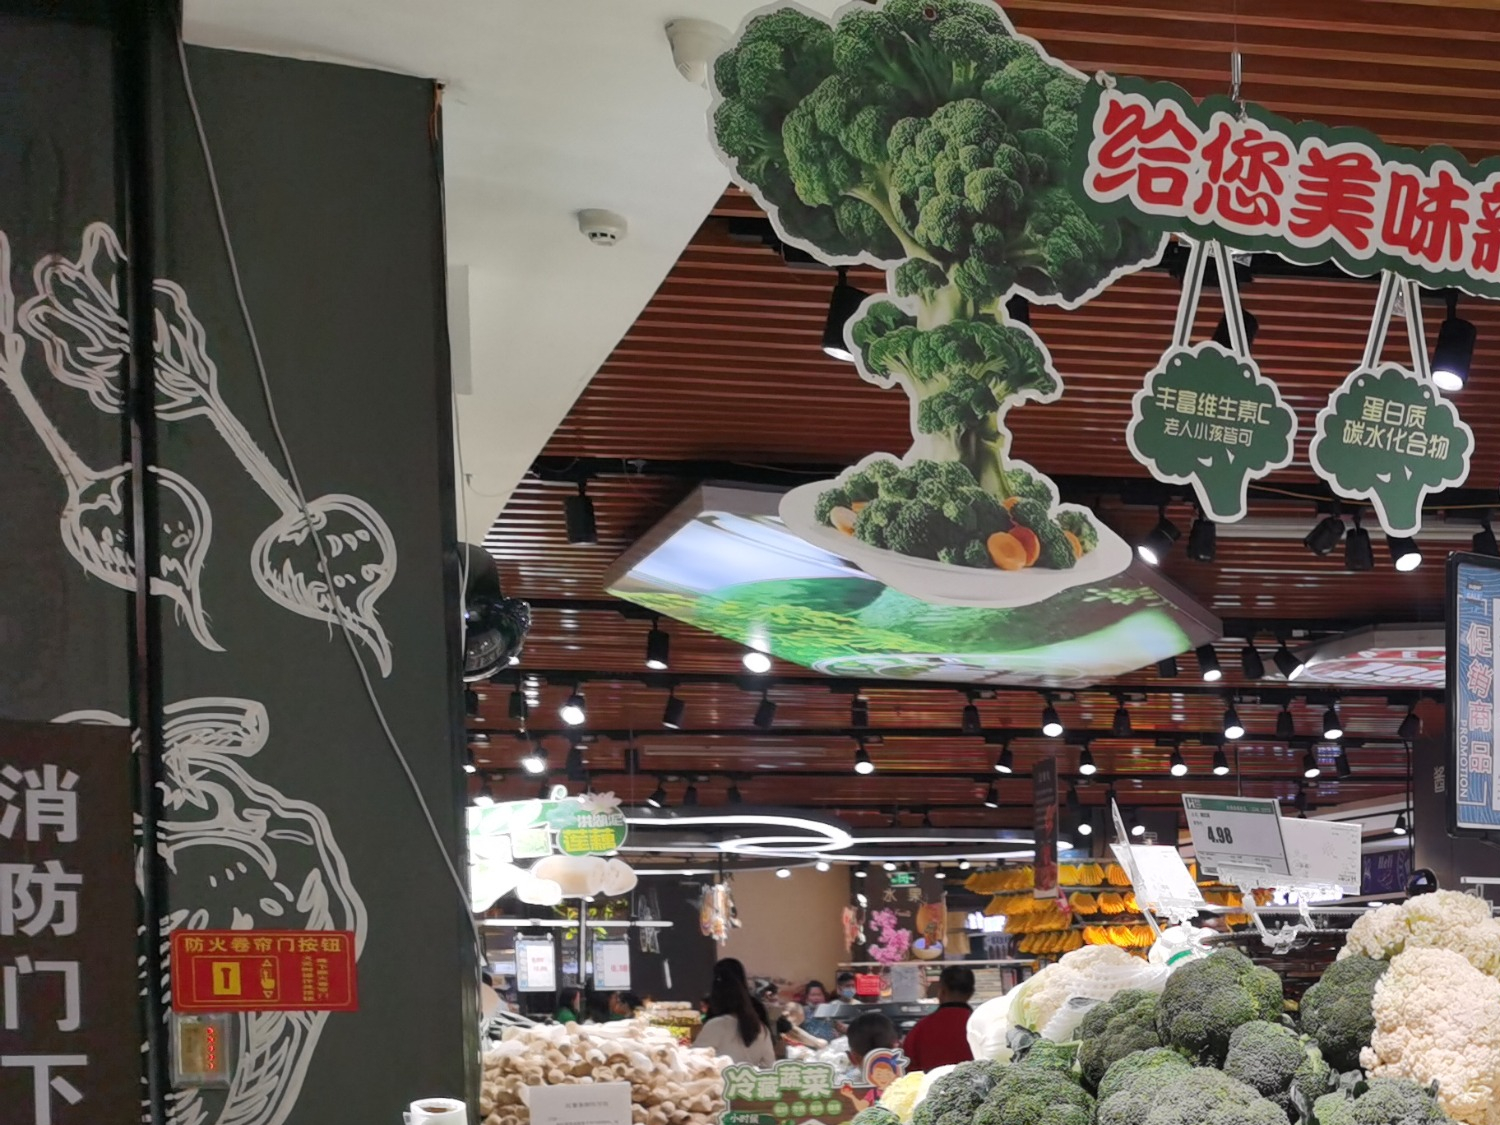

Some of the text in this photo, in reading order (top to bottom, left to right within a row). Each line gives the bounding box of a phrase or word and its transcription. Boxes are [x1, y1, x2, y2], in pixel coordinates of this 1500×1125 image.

[1361, 396, 1428, 430] 蛋白质
[1164, 417, 1254, 448] 老人小孩皆可
[1342, 419, 1450, 461] 碳水化合物
[1466, 622, 1493, 774] 促销商品
[1460, 719, 1469, 798] PROMOTION
[1207, 826, 1233, 844] 4.98
[185, 937, 341, 952] 防火卷帘门按钮
[727, 1066, 832, 1099] 冷藏蔬菜
